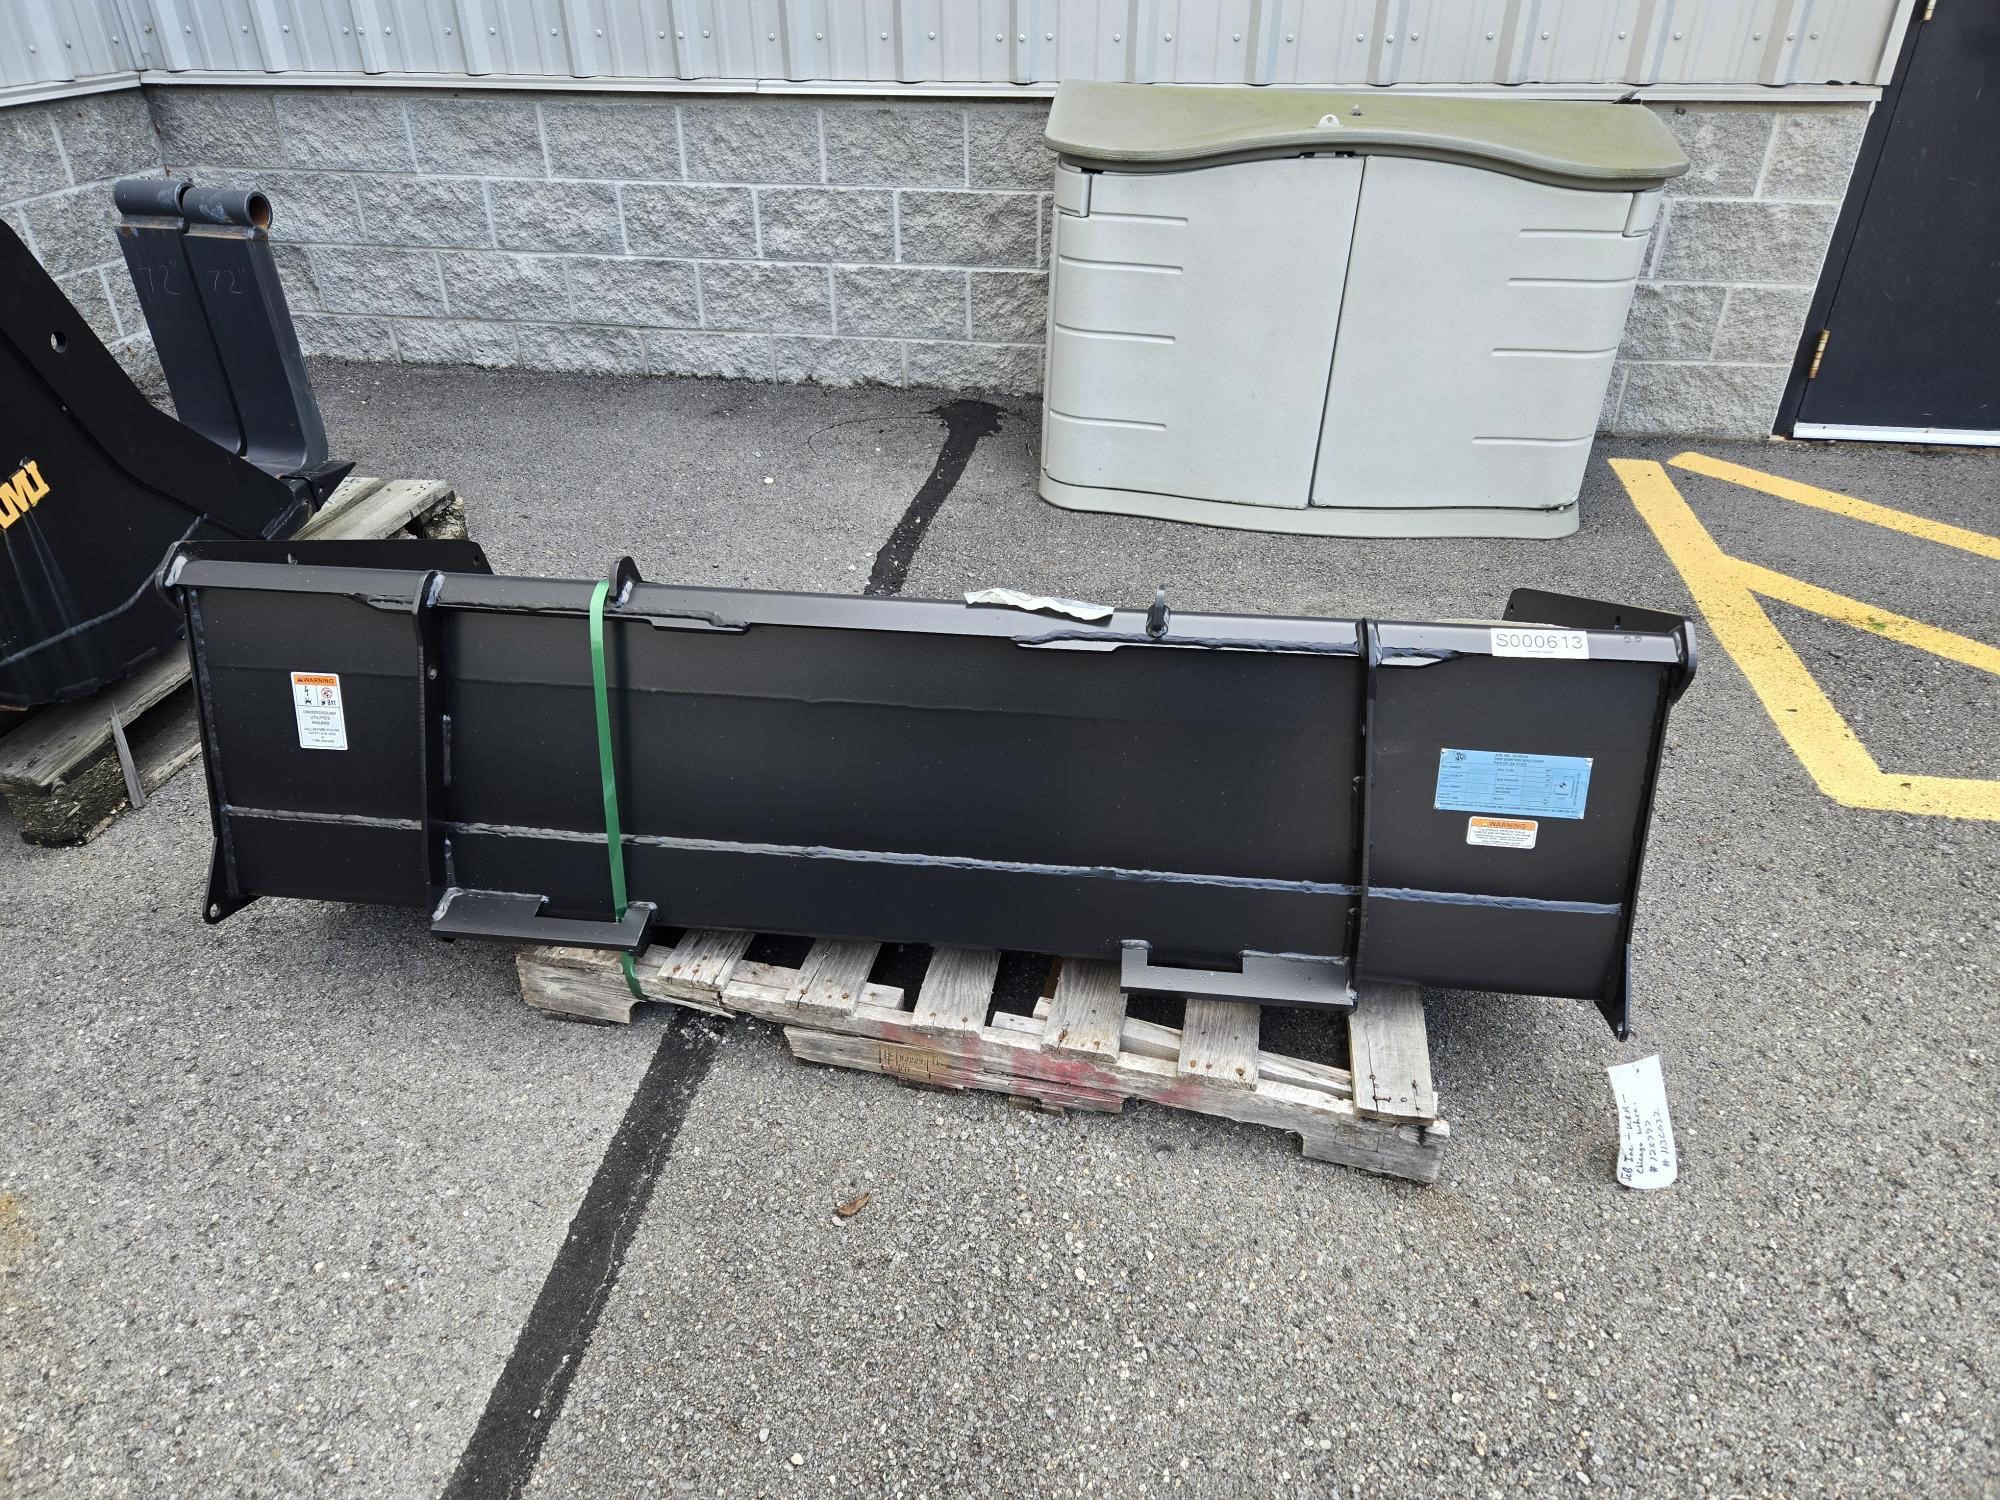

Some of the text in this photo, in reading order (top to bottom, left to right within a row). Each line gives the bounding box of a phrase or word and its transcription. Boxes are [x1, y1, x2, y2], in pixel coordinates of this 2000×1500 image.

[1496, 633, 1583, 649] S000613
[303, 677, 334, 685] WARNING
[1489, 821, 1526, 829] WARNING
